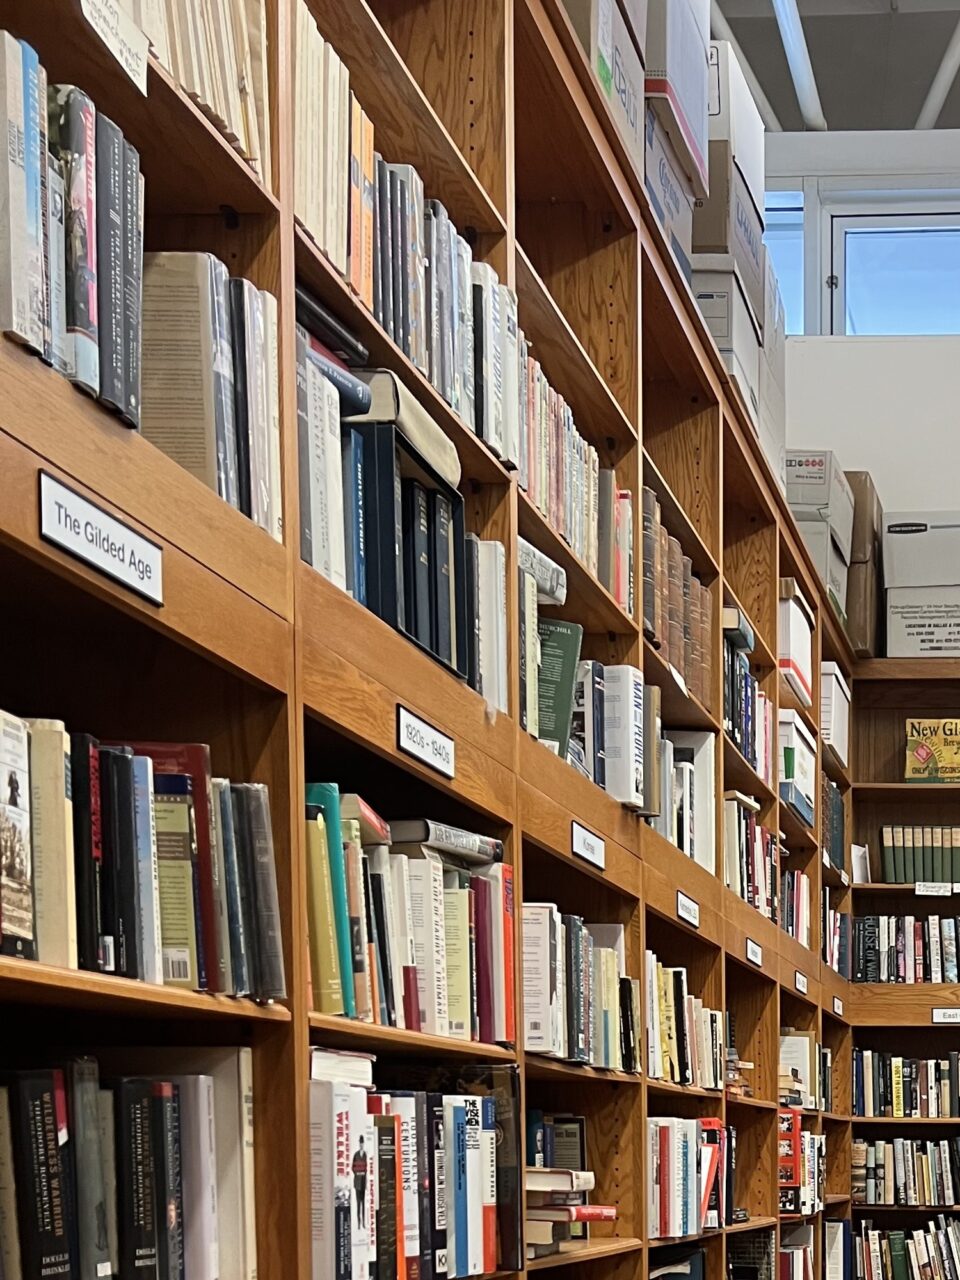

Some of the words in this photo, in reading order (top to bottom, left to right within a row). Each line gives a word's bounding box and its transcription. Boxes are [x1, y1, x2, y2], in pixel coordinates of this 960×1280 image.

[114, 259, 122, 314] IMPERIAL
[54, 500, 81, 536] The
[84, 520, 125, 562] Gilded
[128, 549, 152, 581] Age
[632, 679, 642, 711] MAN
[405, 722, 425, 748] 1920s
[430, 738, 451, 765] 1940s
[633, 723, 644, 761] PEOPLE
[910, 721, 940, 738] New
[865, 916, 874, 949] HOUSE
[435, 970, 443, 1014] TRUMAN
[464, 1100, 478, 1108] THE
[34, 1099, 44, 1157] THEODORE
[40, 1161, 51, 1232] ROOSEVELT
[43, 1092, 56, 1175] WILDERNESS
[50, 1179, 64, 1237] WARRIOR
[336, 1111, 344, 1176] WILLKIE
[401, 1121, 411, 1191] CENTURIONS
[137, 1165, 145, 1225] ROOSEVELT
